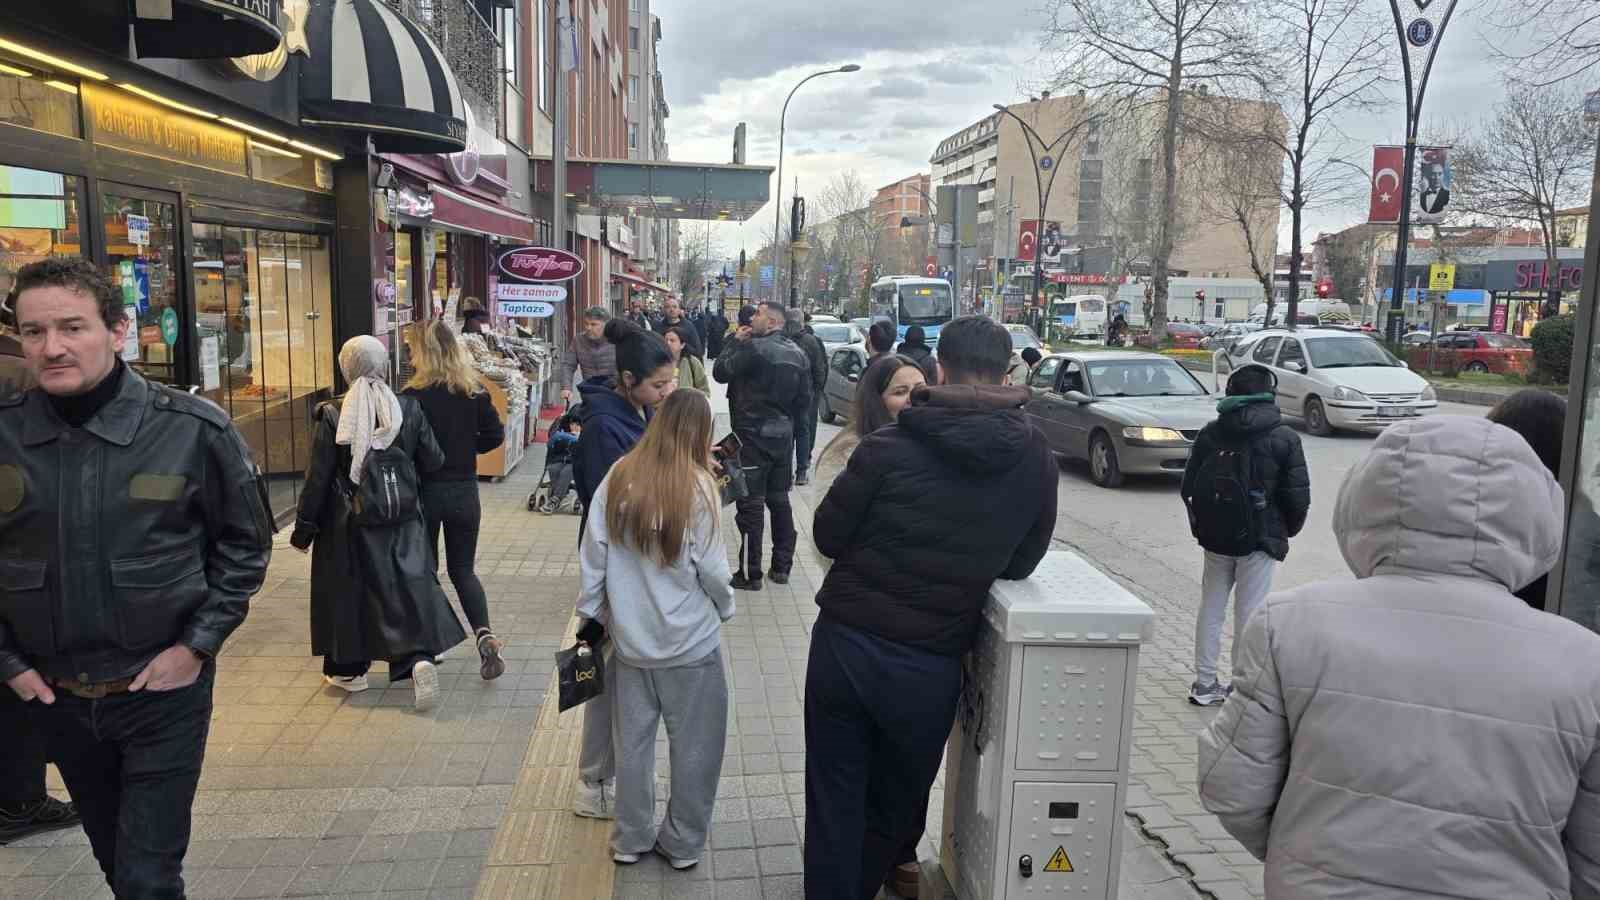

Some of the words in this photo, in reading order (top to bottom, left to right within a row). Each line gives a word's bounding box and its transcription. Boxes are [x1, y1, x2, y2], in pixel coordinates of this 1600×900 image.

[502, 285, 521, 296] Her
[523, 287, 559, 297] zaman
[503, 303, 544, 314] Taptaze
